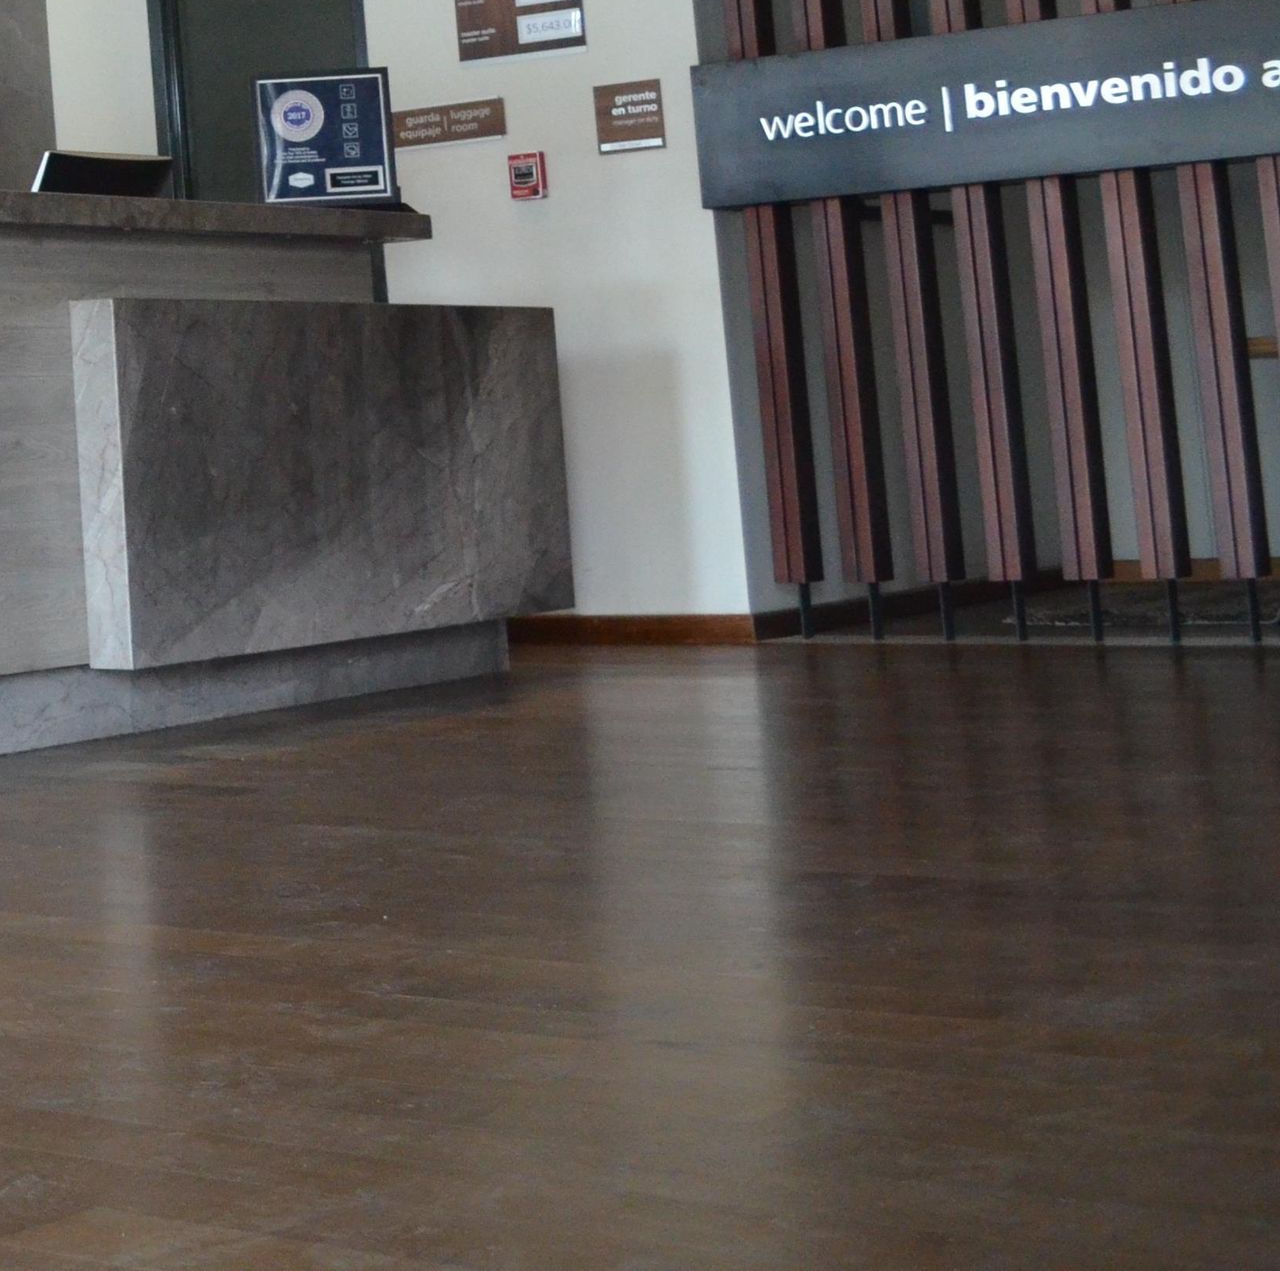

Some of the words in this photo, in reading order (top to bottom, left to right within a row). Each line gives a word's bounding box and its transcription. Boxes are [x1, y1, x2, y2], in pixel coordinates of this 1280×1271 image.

[614, 91, 657, 105] gerente
[759, 100, 928, 141] welcome
[964, 57, 1246, 120] bienvenido
[449, 107, 491, 120] luggage
[611, 107, 626, 116] en
[627, 103, 658, 114] turno
[406, 112, 440, 127] guarda
[400, 125, 441, 139] equipaje
[451, 122, 478, 133] room
